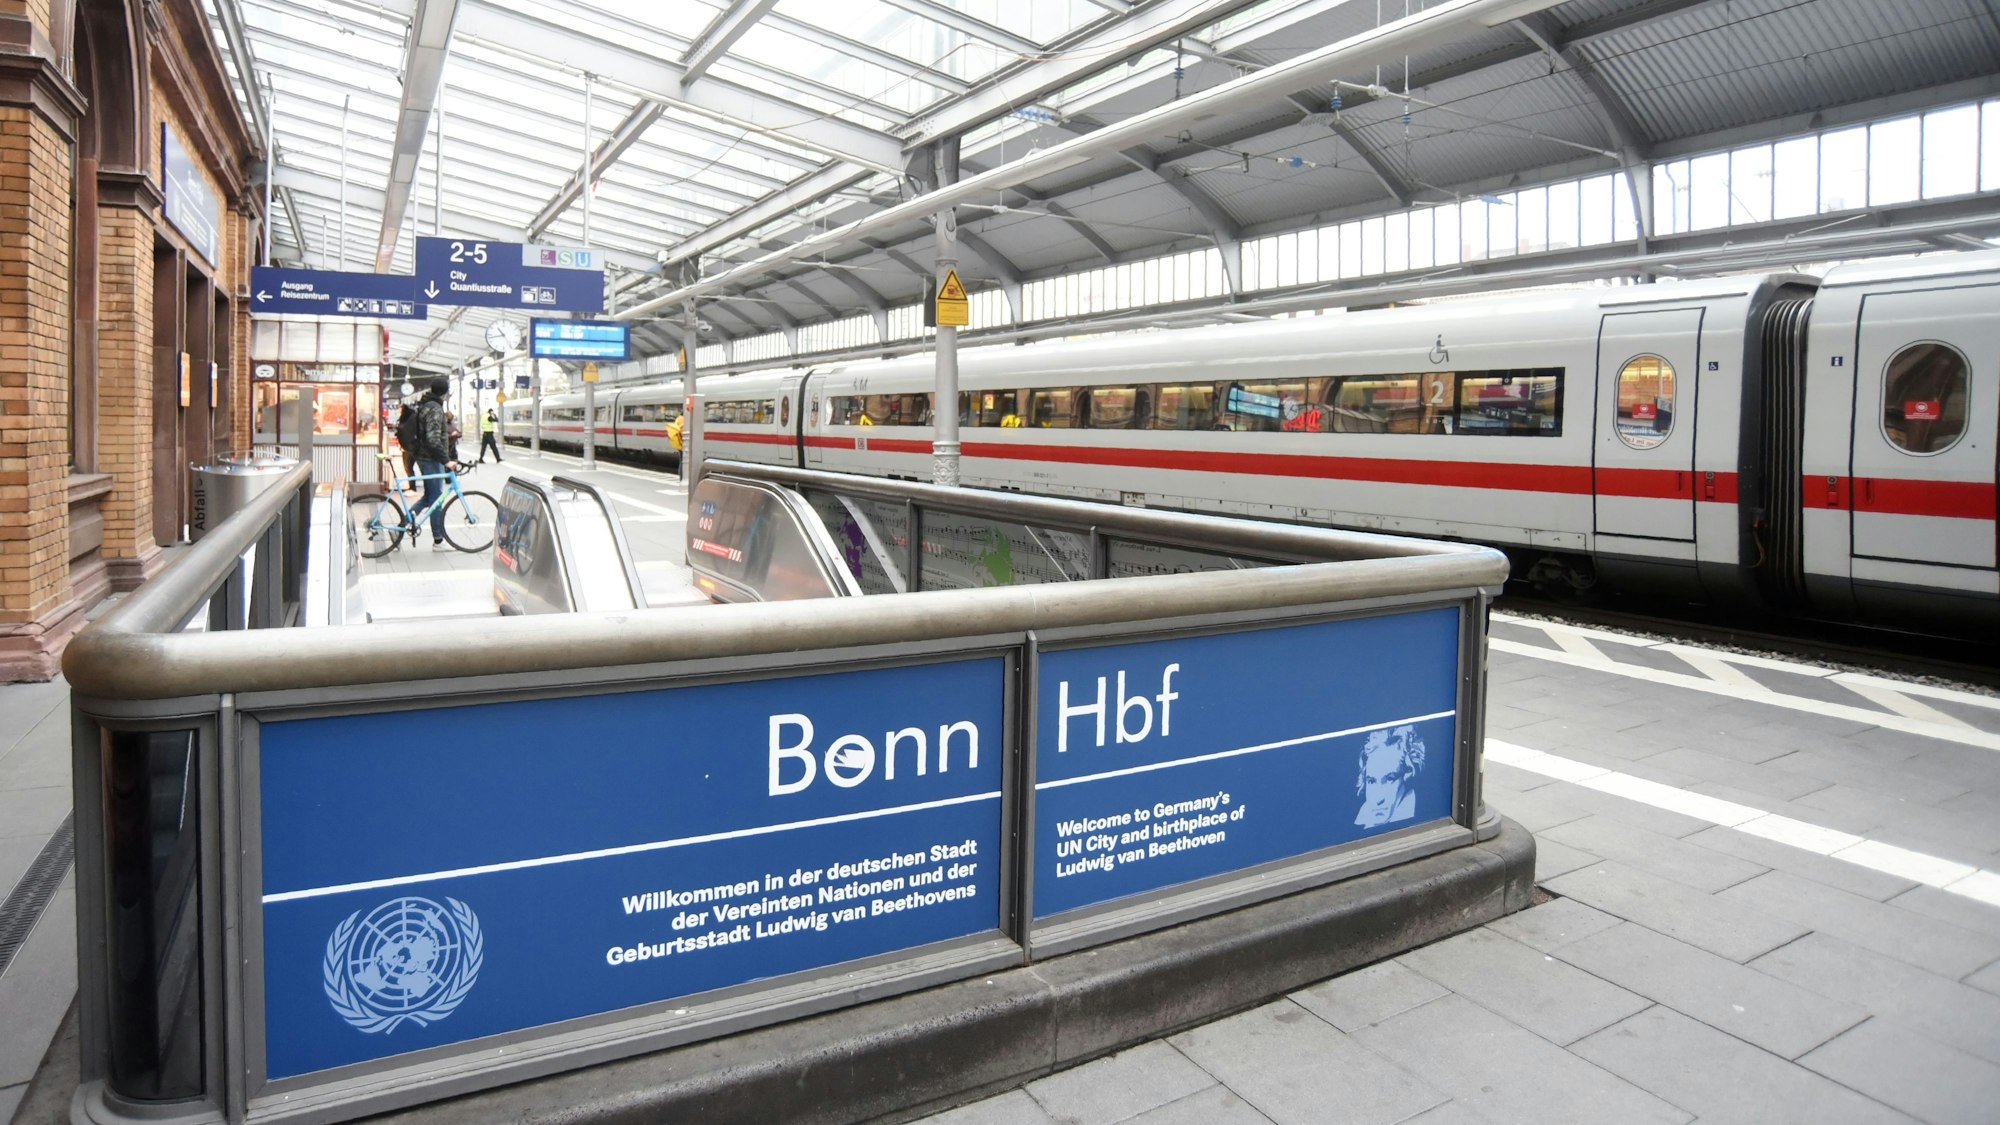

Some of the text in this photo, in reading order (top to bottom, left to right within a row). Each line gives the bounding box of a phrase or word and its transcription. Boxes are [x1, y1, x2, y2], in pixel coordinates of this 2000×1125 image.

[450, 241, 487, 264] 2-5
[559, 251, 572, 266] S
[577, 252, 589, 267] U
[280, 290, 330, 300] Reisezentrum
[281, 280, 314, 291] Ausgang
[450, 270, 467, 281] City
[450, 282, 512, 294] Quantiusstraße
[1430, 381, 1444, 404] 2
[194, 489, 205, 531] Abfall
[769, 663, 1180, 796] Bonn Hbf
[1057, 790, 1230, 838] Welcome to Germany's
[1057, 804, 1245, 857] UN City and birthplace of
[1057, 830, 1226, 878] Ludwig van Beethoven
[622, 840, 978, 915] Willkommen in der deutschen Stadt
[672, 862, 978, 931] der Vereinten Nationen und der
[606, 885, 976, 966] Geburtsstadt Ludwig van Beethovens
